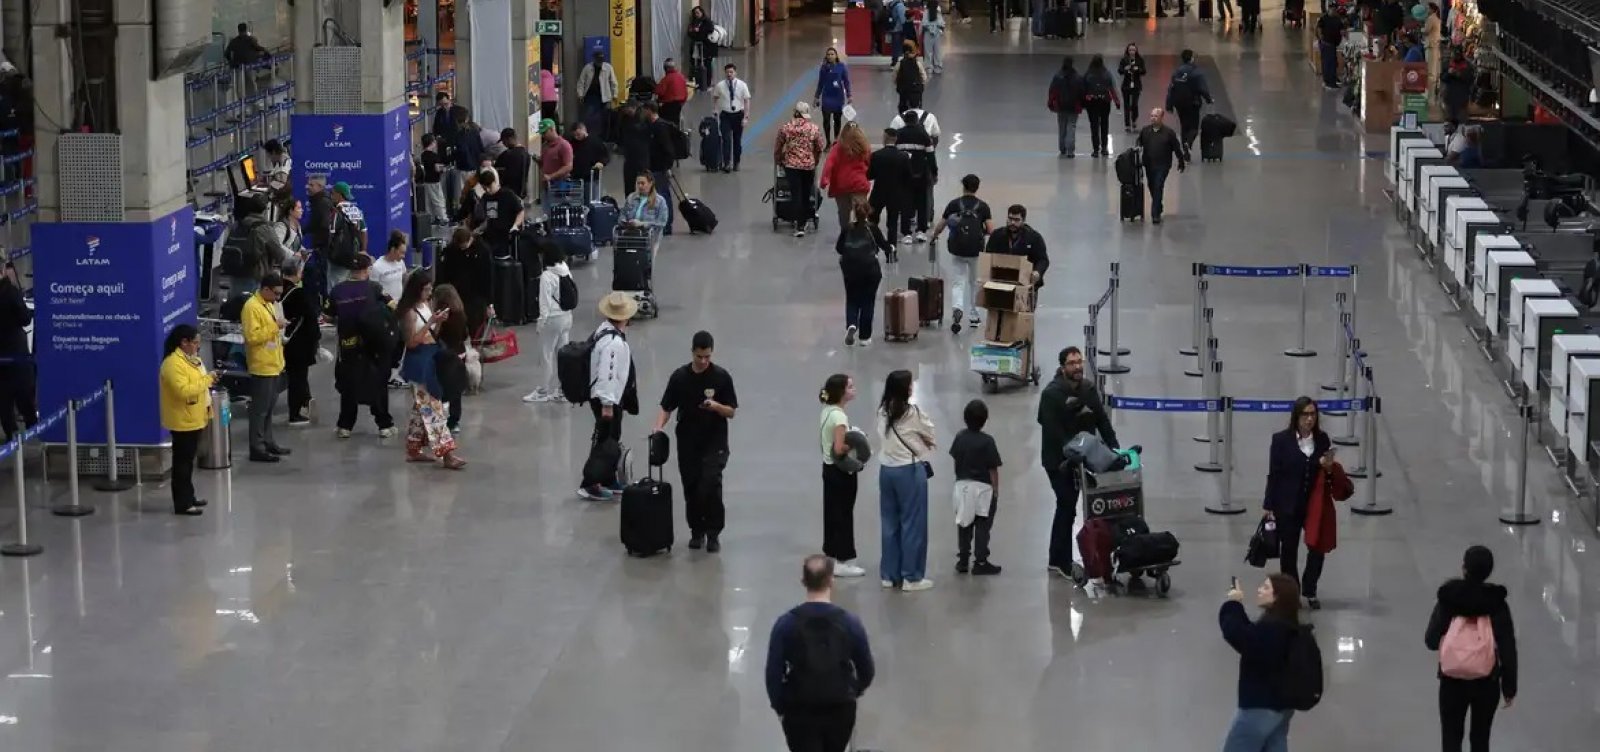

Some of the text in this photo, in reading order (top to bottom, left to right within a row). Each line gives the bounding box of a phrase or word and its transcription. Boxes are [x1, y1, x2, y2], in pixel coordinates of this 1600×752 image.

[304, 160, 362, 171] Começa aqui!
[76, 258, 110, 266] LATAM
[50, 282, 124, 296] Começa aqui!
